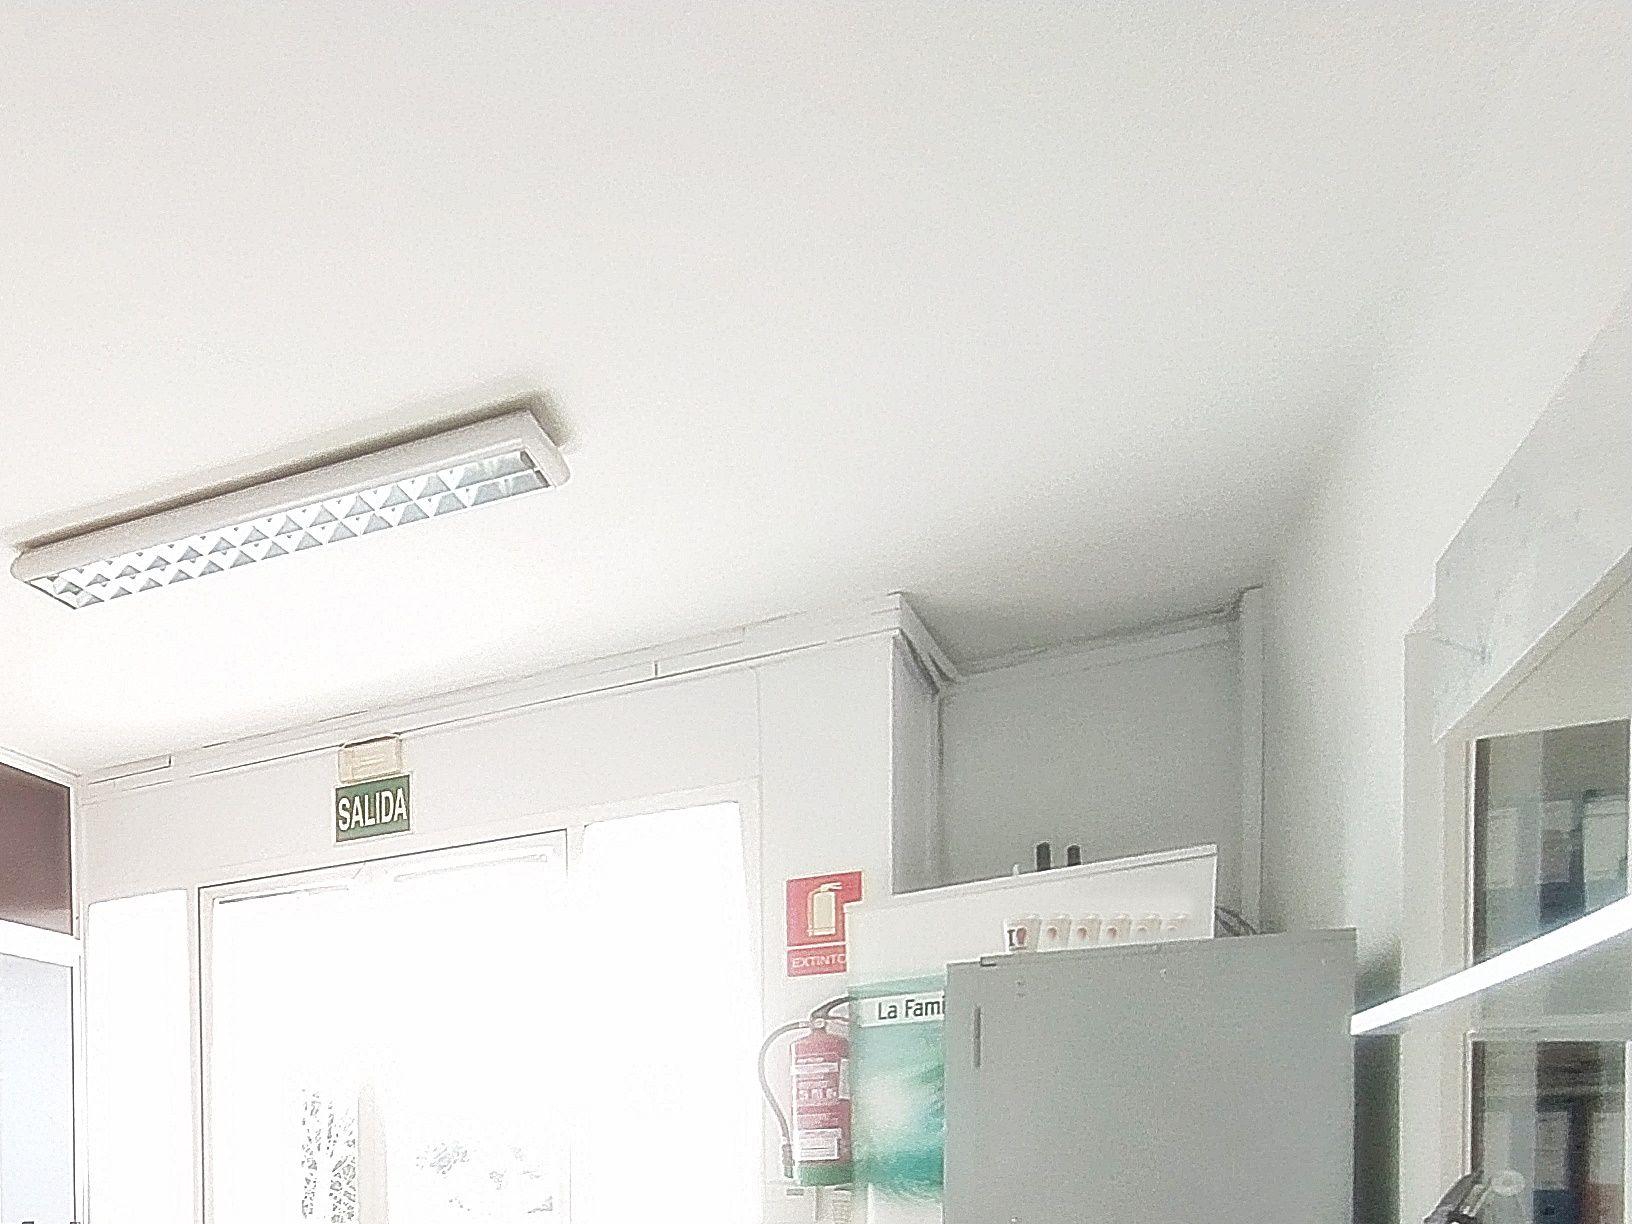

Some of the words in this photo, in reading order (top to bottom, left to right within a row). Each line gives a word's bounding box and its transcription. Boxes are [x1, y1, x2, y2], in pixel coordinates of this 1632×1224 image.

[338, 787, 408, 832] SALIDA
[877, 1002, 898, 1020] La
[904, 995, 946, 1018] Fami
